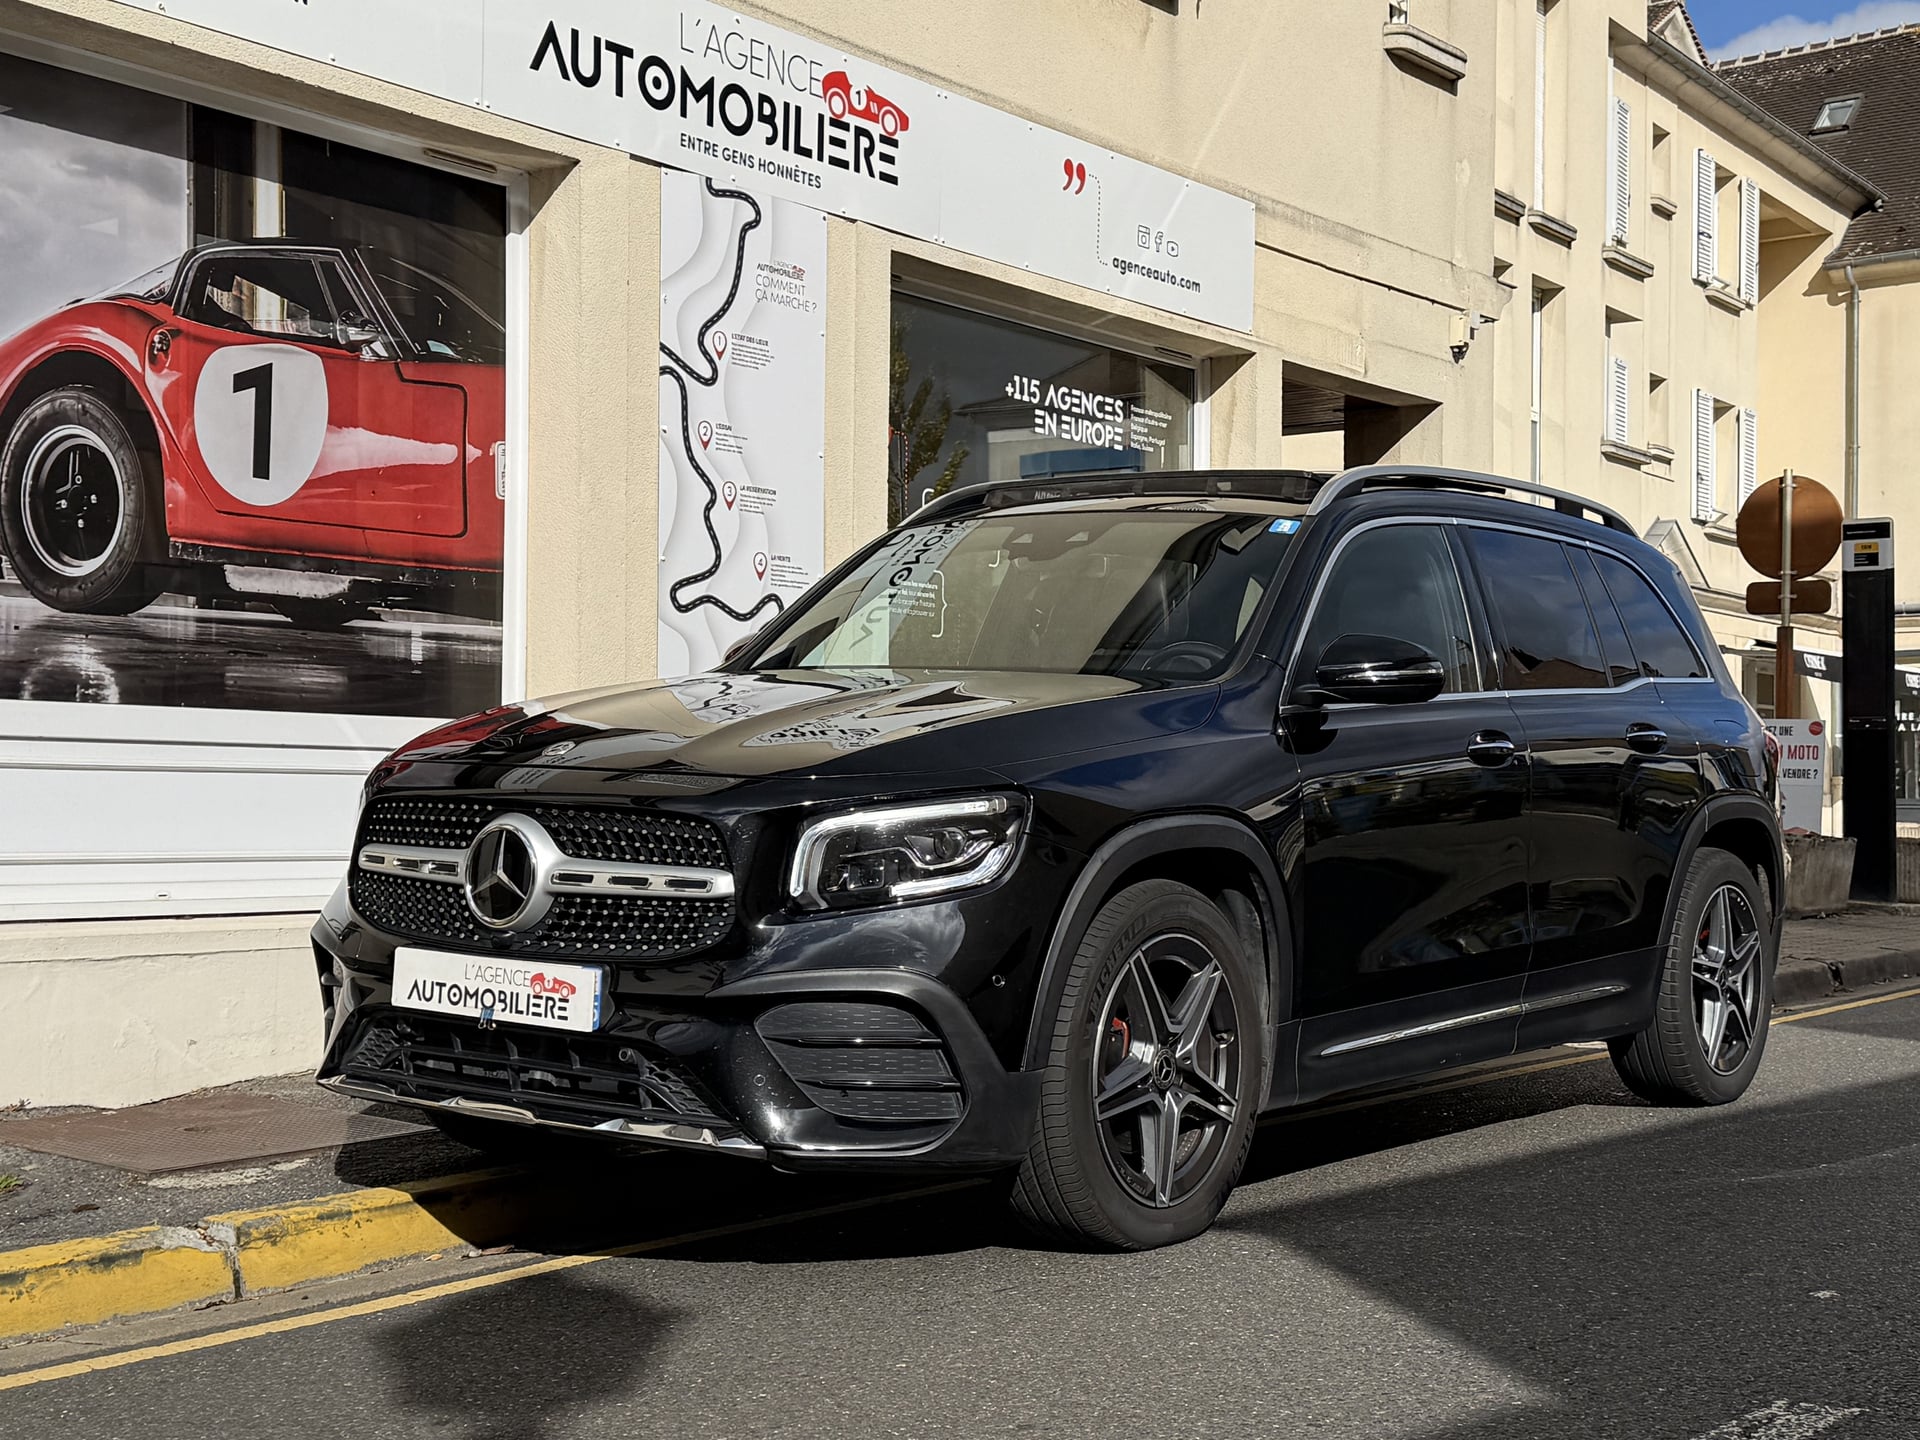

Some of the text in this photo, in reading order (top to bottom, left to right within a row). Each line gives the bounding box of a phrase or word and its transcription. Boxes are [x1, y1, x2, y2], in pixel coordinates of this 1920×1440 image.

[681, 12, 823, 98] L'AGENCE
[680, 133, 822, 189] ENTRE GENS HONNÊTES
[755, 273, 806, 296] COMMENT
[1112, 256, 1201, 293] agenceauto.com
[755, 288, 818, 313] ÇA MARCHE ?
[1005, 375, 1124, 423] +115 AGENCES
[232, 361, 274, 481] 1
[703, 426, 709, 436] 2
[1034, 409, 1123, 451] EN EUROPE
[728, 486, 732, 497] 3
[758, 558, 763, 567] 4
[1779, 726, 1794, 736] UNE
[1787, 744, 1819, 761] MOTO
[1782, 768, 1818, 780] VENDRE ?
[464, 963, 532, 987] L'AGENCE
